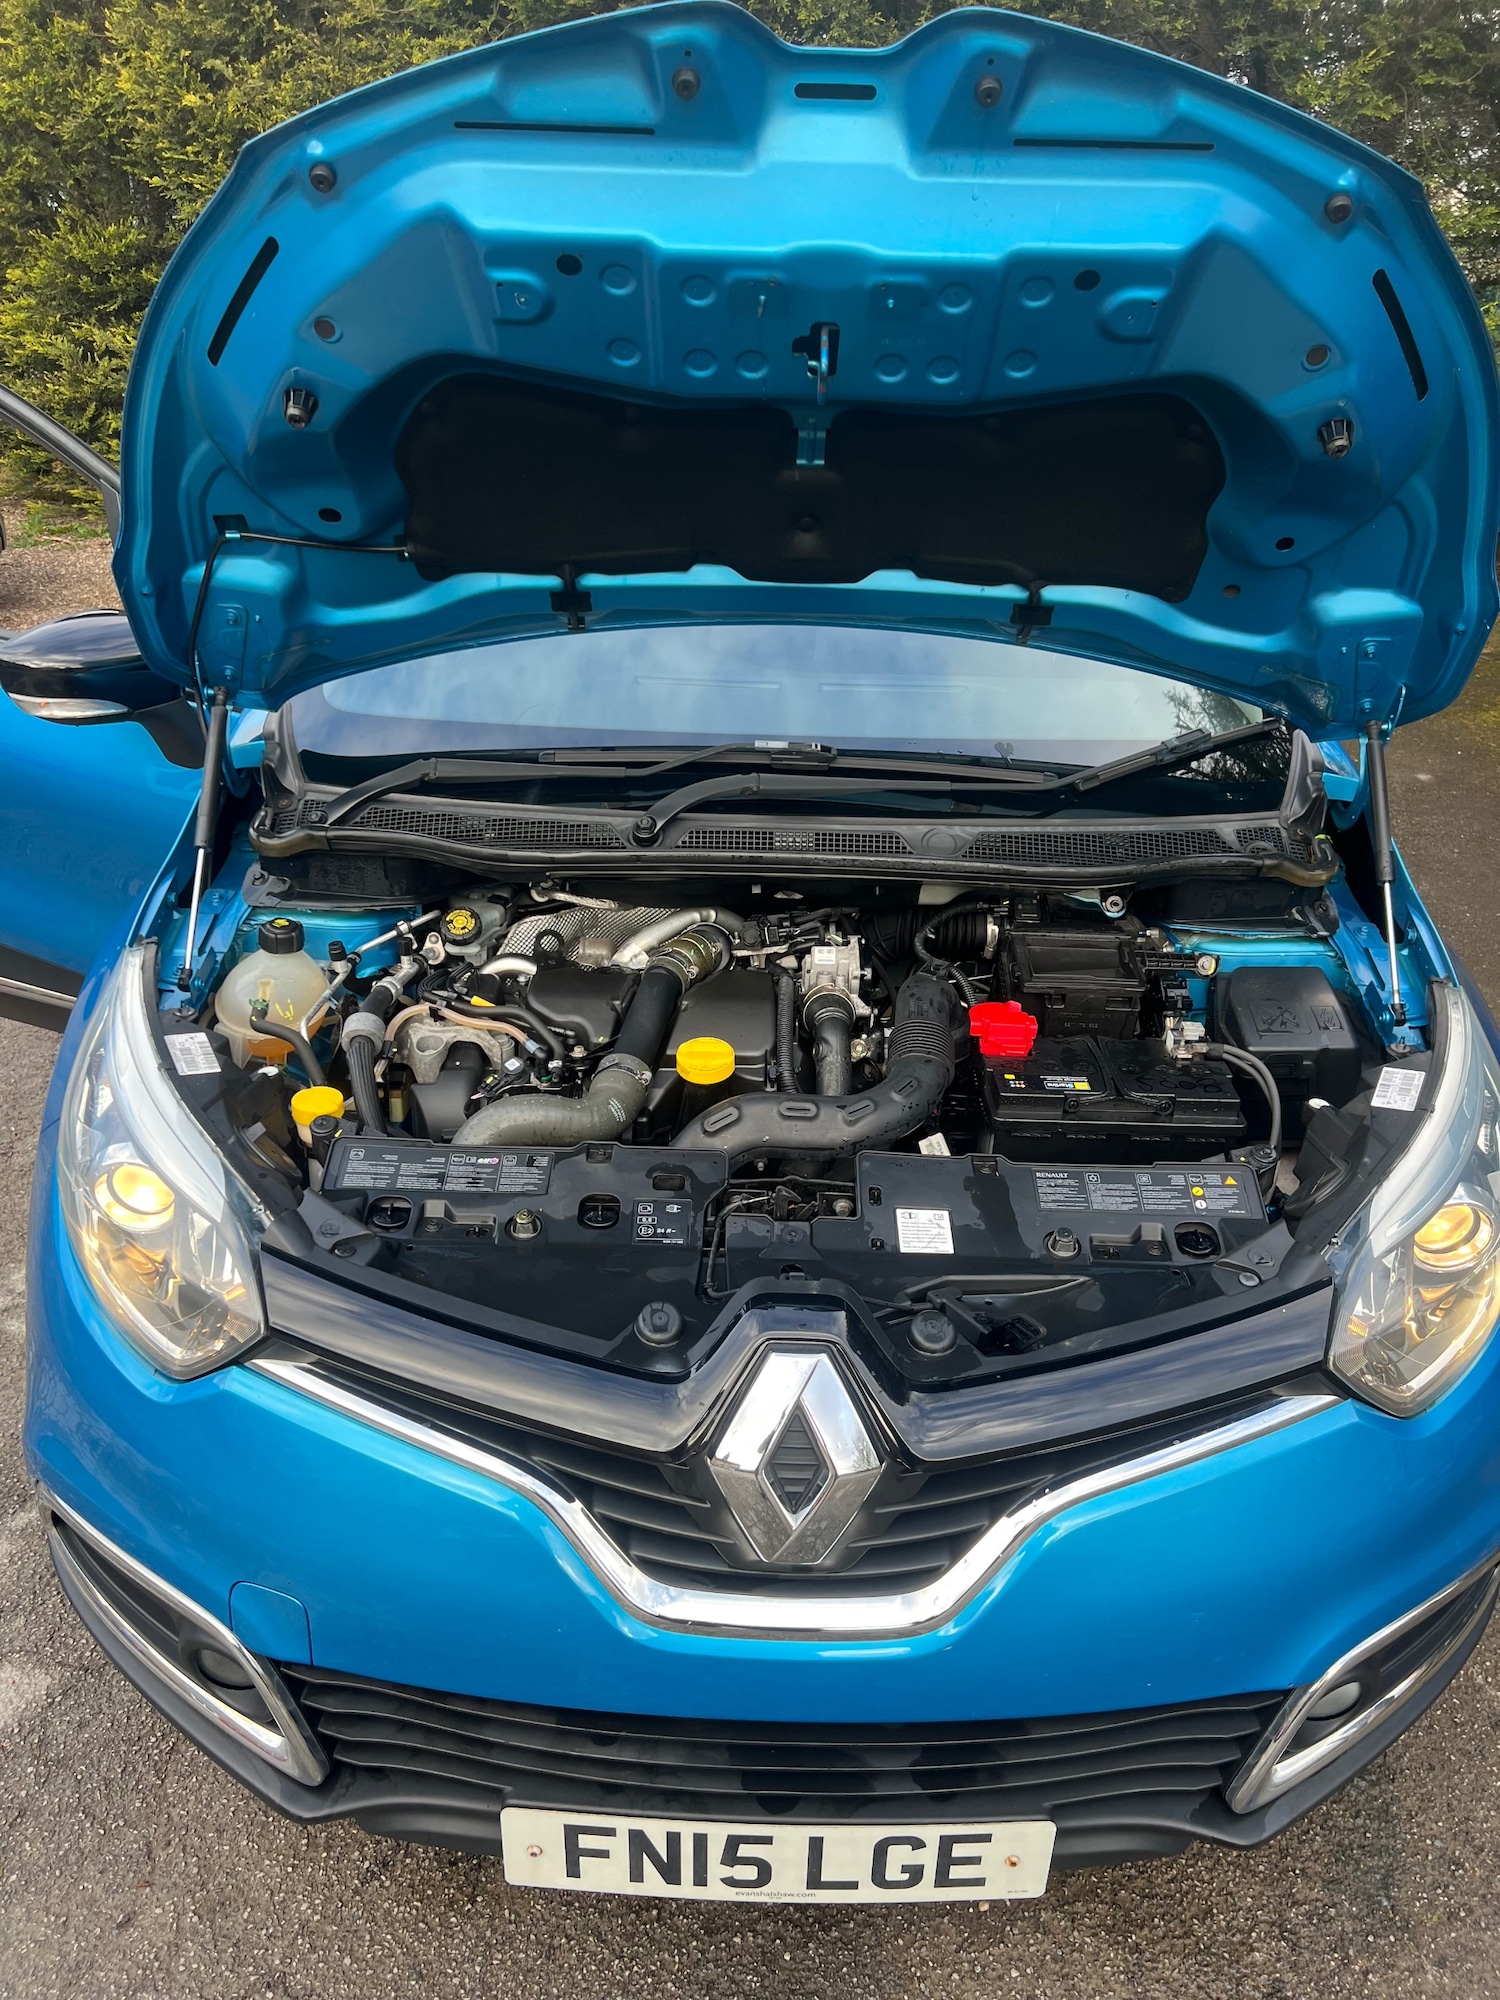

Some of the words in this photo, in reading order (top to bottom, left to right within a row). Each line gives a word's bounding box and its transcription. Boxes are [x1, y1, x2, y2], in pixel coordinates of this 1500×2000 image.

[1035, 1171, 1069, 1179] RENAULT
[563, 1823, 774, 1888] FN15
[806, 1833, 993, 1891] LGE
[735, 1890, 817, 1898] evanshalshaw.com
